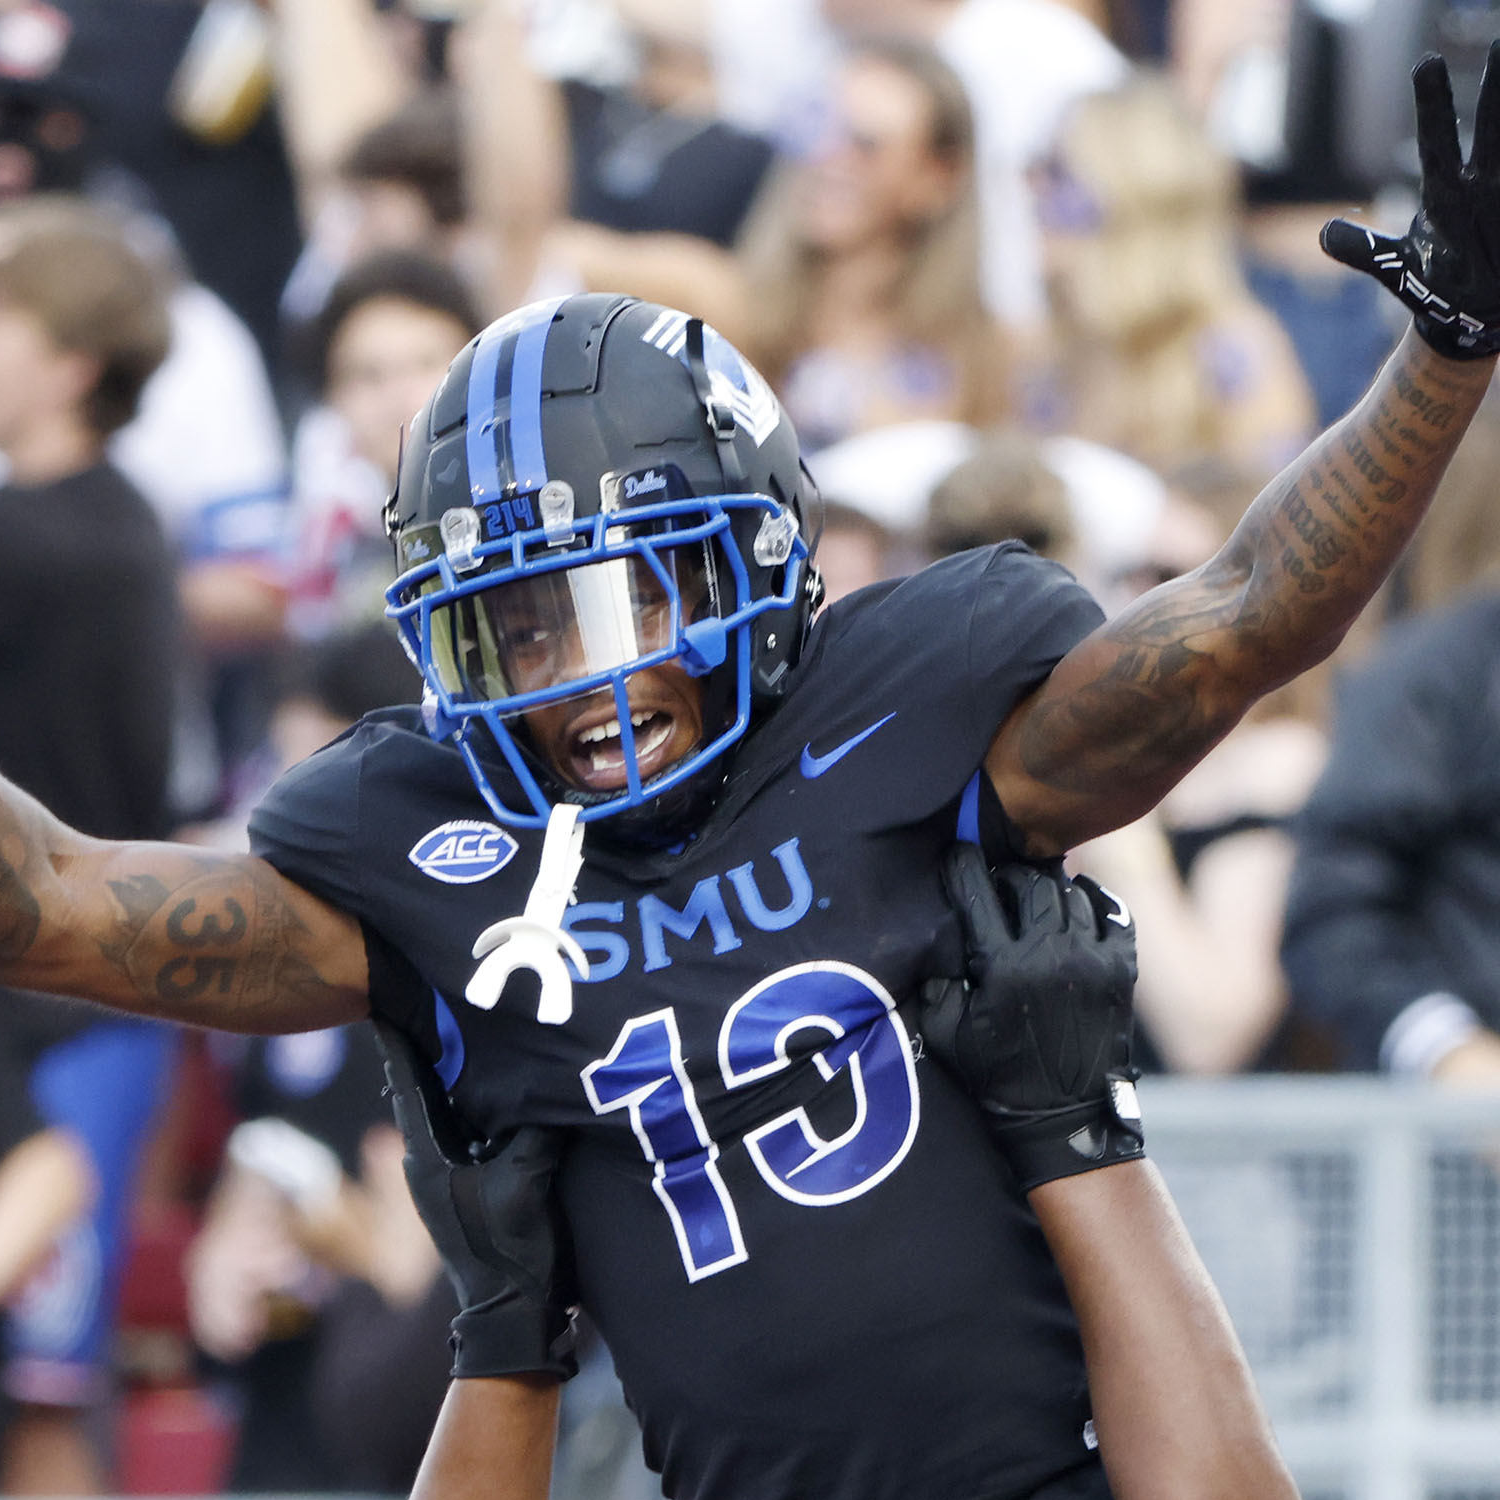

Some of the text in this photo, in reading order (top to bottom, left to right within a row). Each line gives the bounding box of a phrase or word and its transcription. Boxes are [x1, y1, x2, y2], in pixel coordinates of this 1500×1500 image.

[484, 495, 536, 538] 214
[425, 832, 504, 862] ACC
[155, 897, 248, 1001] 35
[560, 836, 814, 984] SMU
[580, 960, 921, 1284] 13
